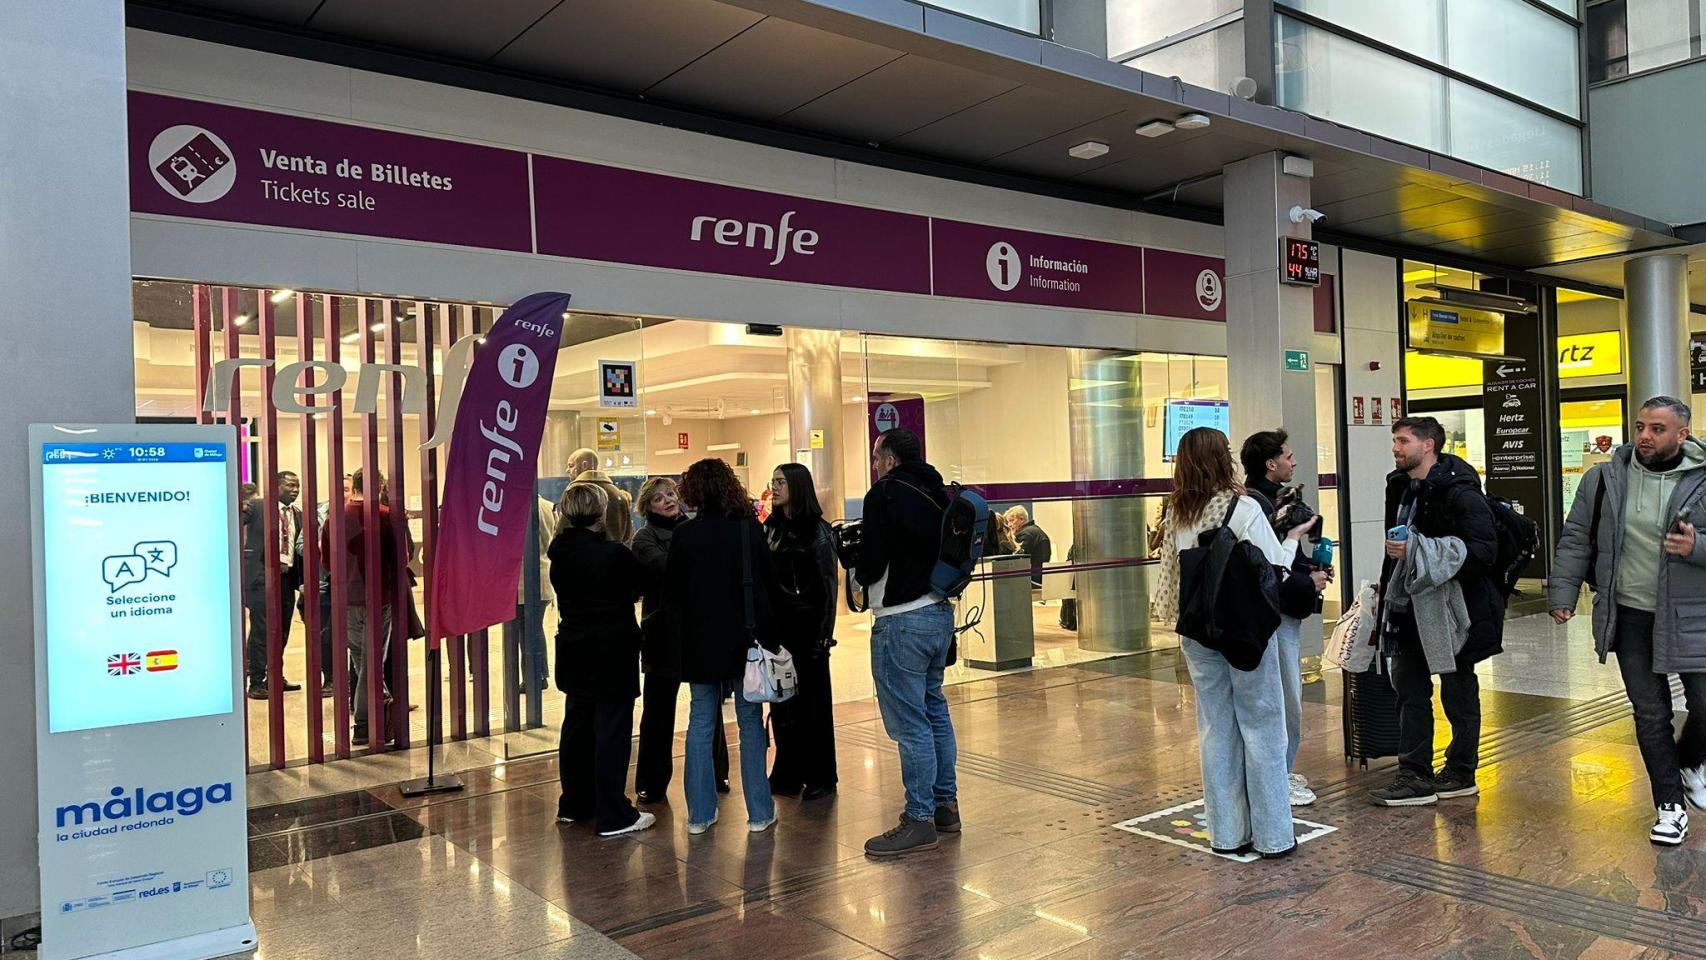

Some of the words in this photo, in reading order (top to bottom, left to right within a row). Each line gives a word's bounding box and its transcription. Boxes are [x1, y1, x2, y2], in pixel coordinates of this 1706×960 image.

[260, 148, 328, 176] Venta
[336, 158, 364, 179] de
[370, 163, 453, 192] Billetes
[261, 179, 331, 207] Tickets
[337, 188, 376, 211] sale
[690, 210, 820, 266] renfe
[1030, 254, 1088, 274] Información
[1288, 263, 1302, 278] 44
[1030, 274, 1080, 292] Information
[514, 318, 555, 338] renfe
[1560, 344, 1594, 362] rtz
[203, 333, 487, 451] renf
[1499, 414, 1525, 422] Hertz
[1496, 427, 1529, 435] Europcar
[129, 447, 166, 458] 10:58
[1502, 440, 1524, 449] AVIS
[478, 399, 524, 536] renfe
[84, 491, 190, 507] ¡BIENVENIDO!
[106, 593, 176, 606] Seleccione
[110, 608, 126, 618] un
[130, 606, 172, 617] idioma
[56, 832, 68, 842] la
[72, 825, 118, 840] ciudad
[120, 816, 174, 832] redonda
[138, 886, 170, 899] red.es
